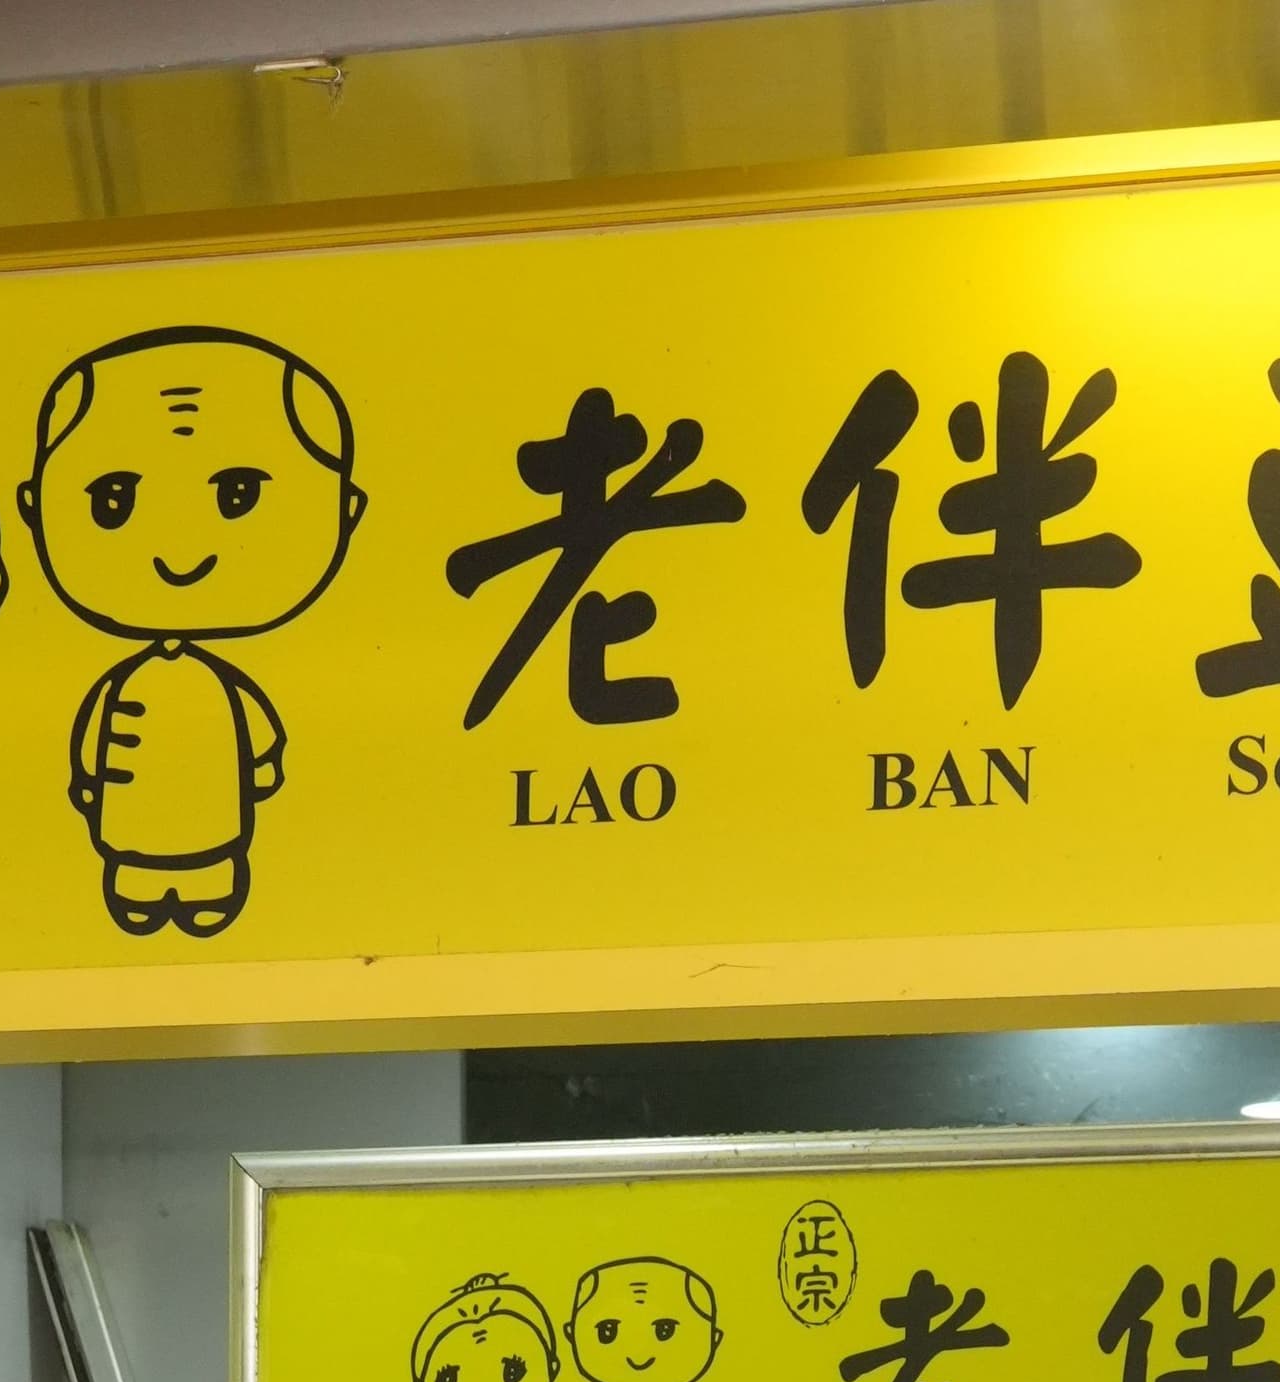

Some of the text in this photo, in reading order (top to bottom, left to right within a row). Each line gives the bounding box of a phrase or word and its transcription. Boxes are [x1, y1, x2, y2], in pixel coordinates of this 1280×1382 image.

[509, 763, 677, 827] LAO
[866, 746, 1038, 813] BAN
[795, 1216, 837, 1313] 正宗
